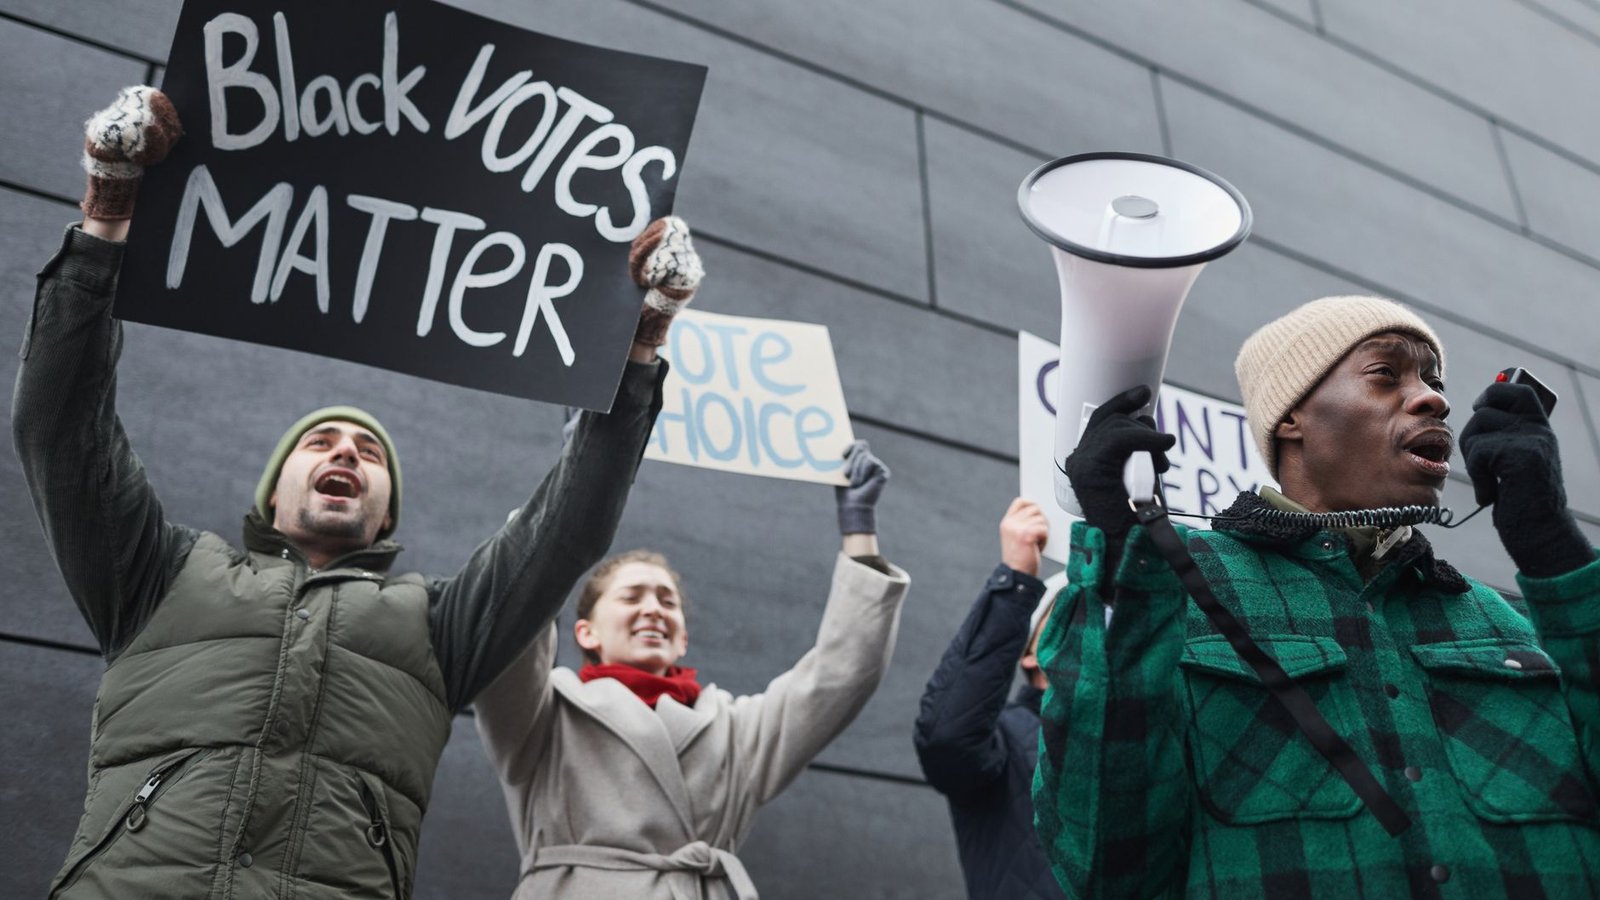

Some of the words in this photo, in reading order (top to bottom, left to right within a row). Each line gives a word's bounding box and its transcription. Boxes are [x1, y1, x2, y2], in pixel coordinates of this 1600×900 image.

[204, 11, 430, 150] Black
[657, 319, 807, 396] OTe
[649, 388, 845, 472] HOICe
